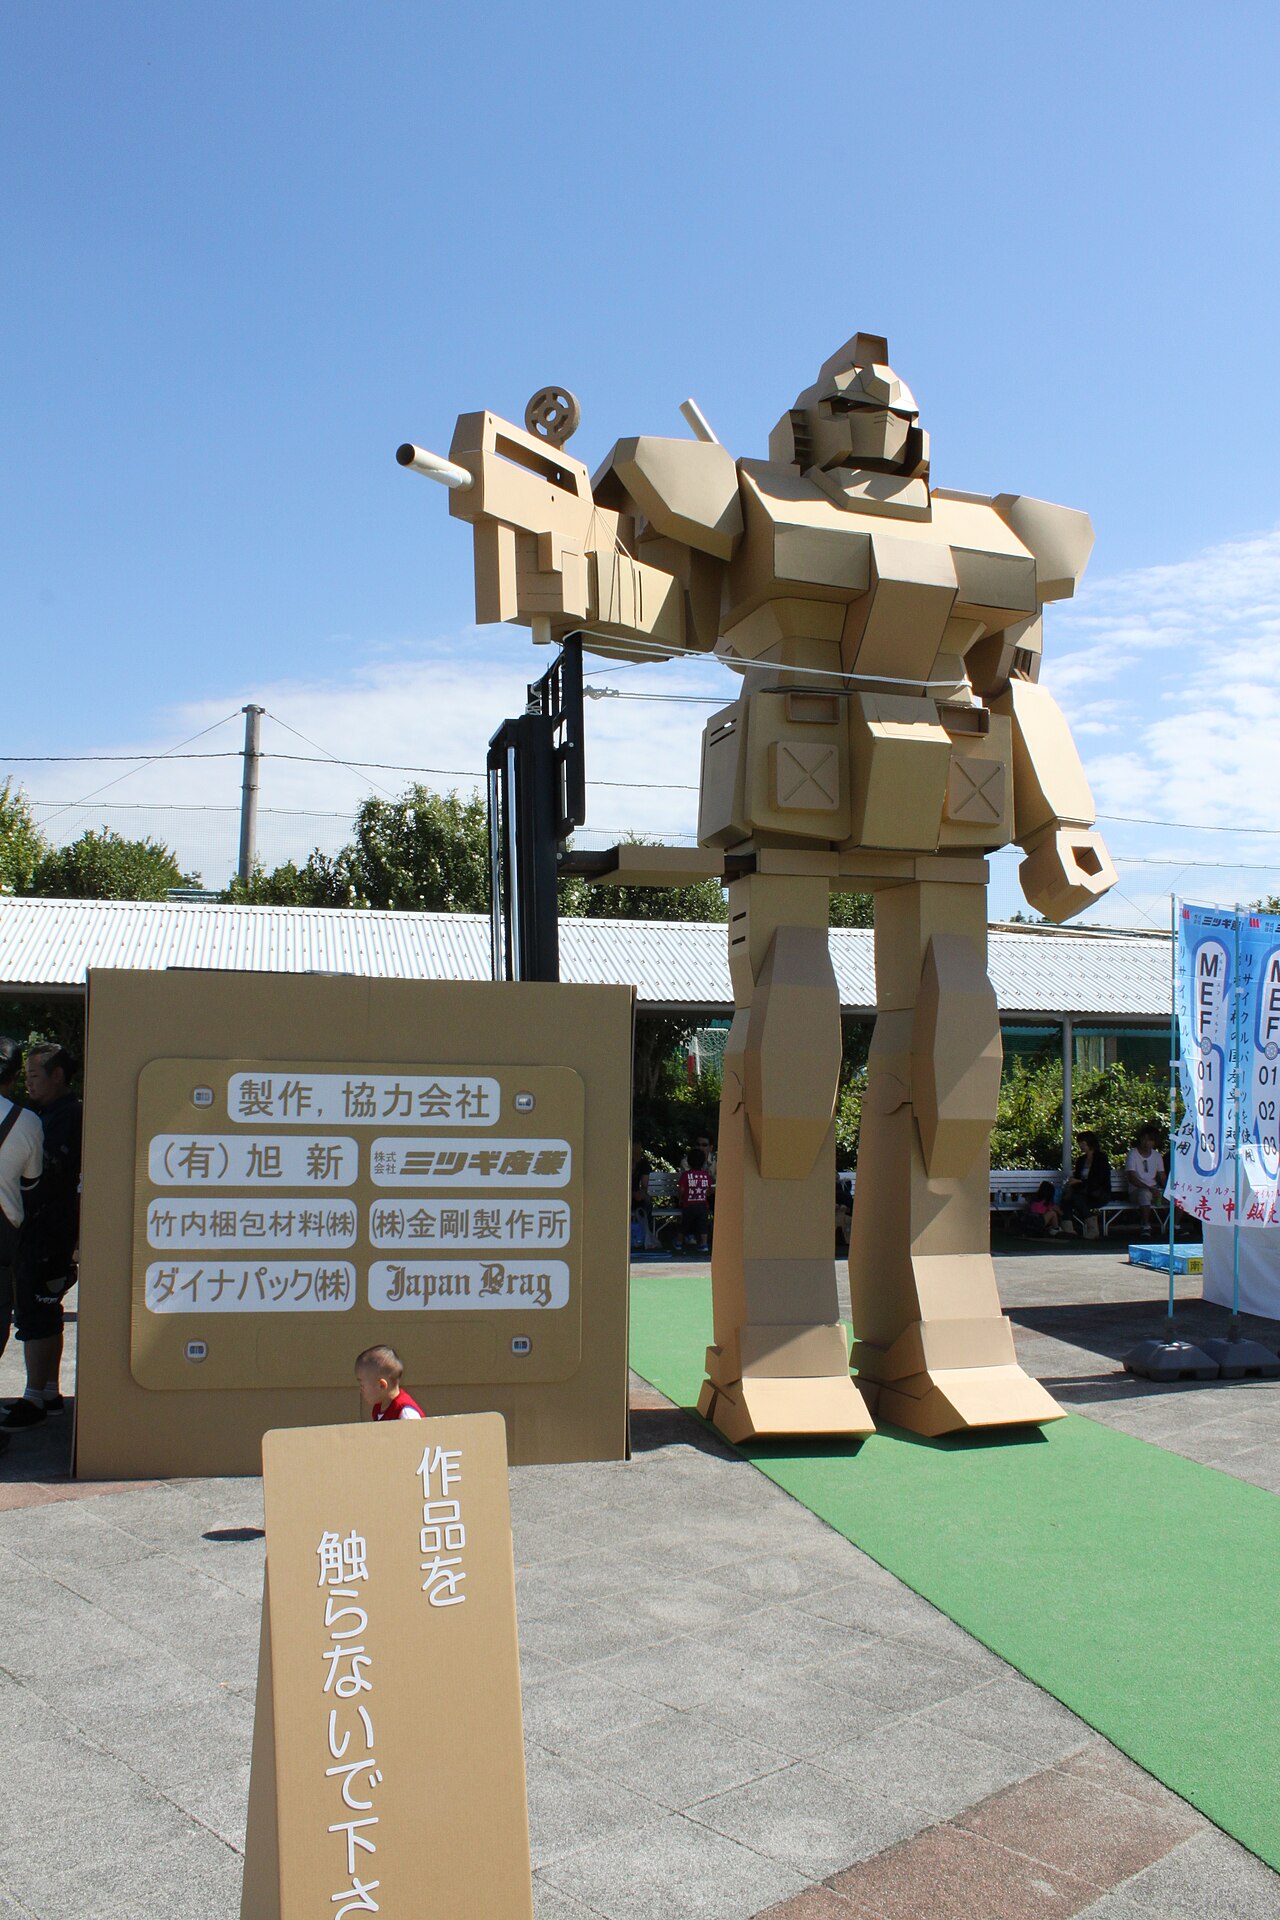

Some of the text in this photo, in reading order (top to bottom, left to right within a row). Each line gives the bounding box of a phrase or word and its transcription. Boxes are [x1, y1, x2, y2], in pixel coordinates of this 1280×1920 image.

[1199, 952, 1219, 1034] MEF
[1197, 1060, 1212, 1082] 01
[1258, 1065, 1278, 1086] 01
[1197, 1096, 1214, 1118] 02
[1258, 1100, 1275, 1121] 02
[1200, 1133, 1216, 1153] 03
[1263, 1136, 1277, 1156] 03
[400, 1150, 568, 1176] ミツギ産業
[386, 1264, 471, 1308] Japan
[416, 1445, 466, 1608] 作品を
